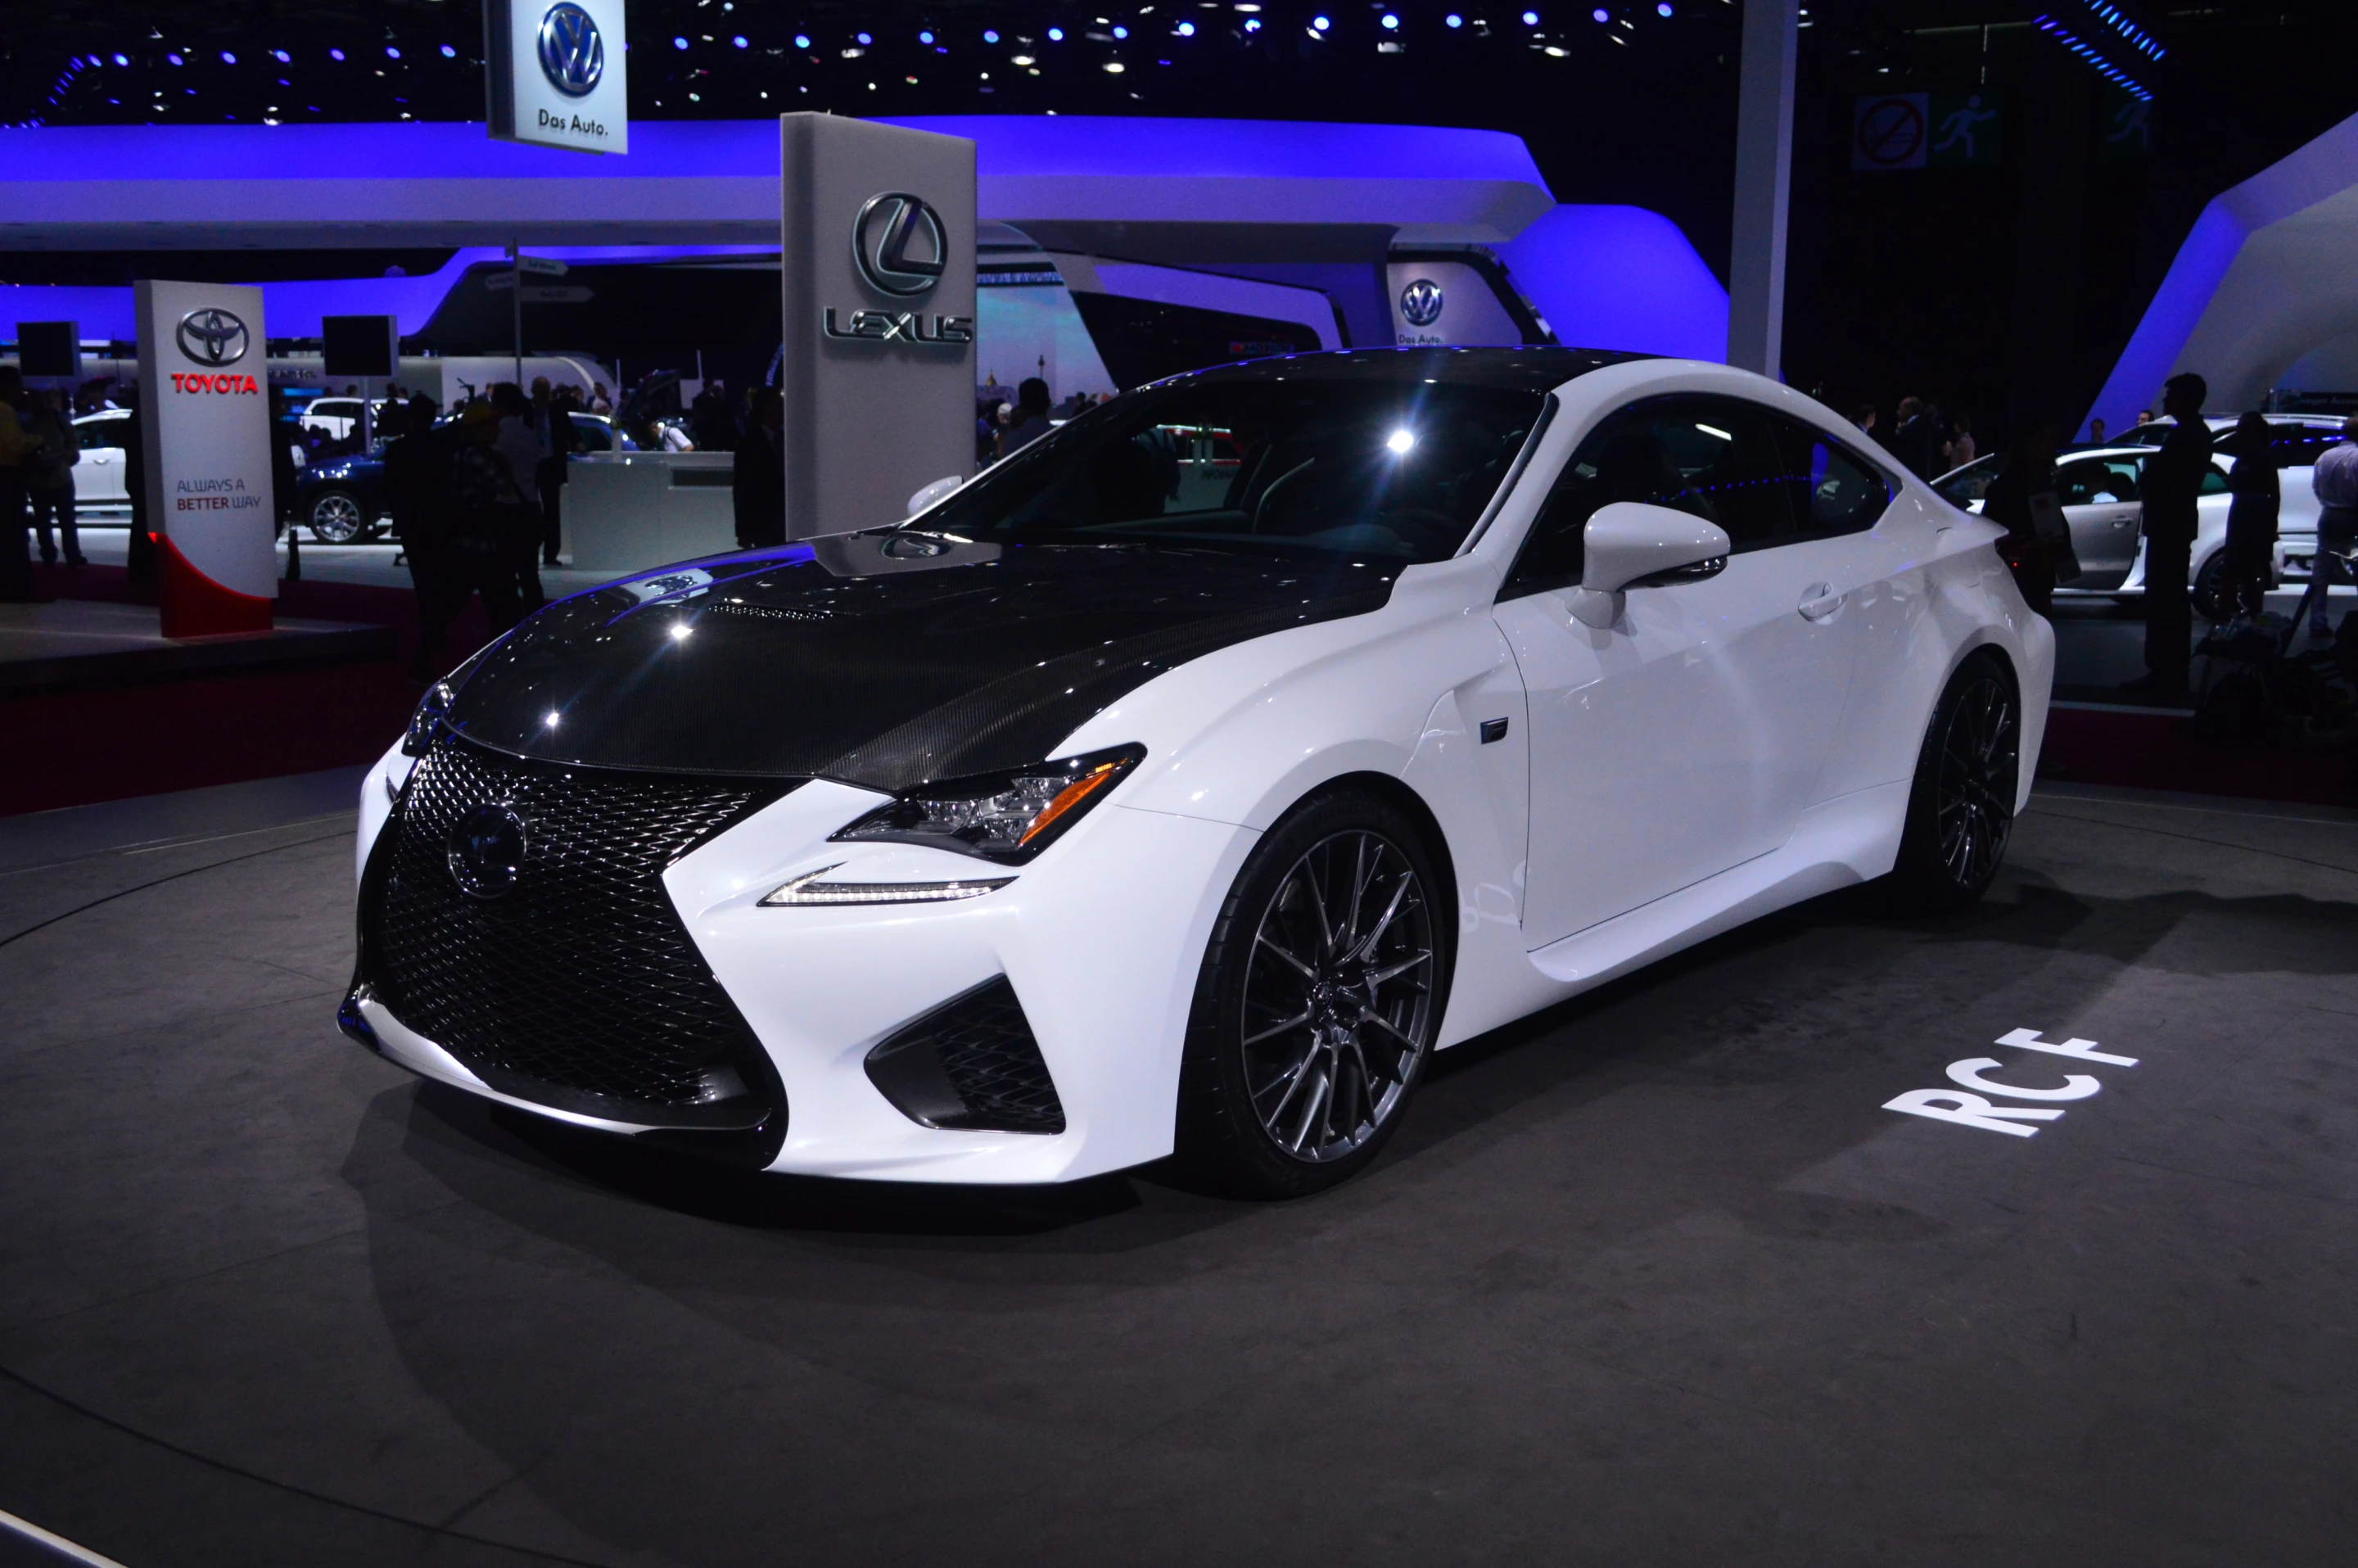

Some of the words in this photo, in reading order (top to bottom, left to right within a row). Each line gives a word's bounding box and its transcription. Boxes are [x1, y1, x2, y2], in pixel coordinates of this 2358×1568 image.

[539, 109, 566, 129] Das
[571, 114, 608, 136] Auto.
[824, 306, 973, 343] LEXUS
[1398, 334, 1416, 344] Das
[1418, 334, 1443, 344] Auto.
[171, 373, 259, 395] TOYOTA
[177, 479, 233, 493] ALWAYS
[235, 478, 246, 491] A
[177, 497, 229, 511] BETTER
[232, 495, 261, 509] WAY
